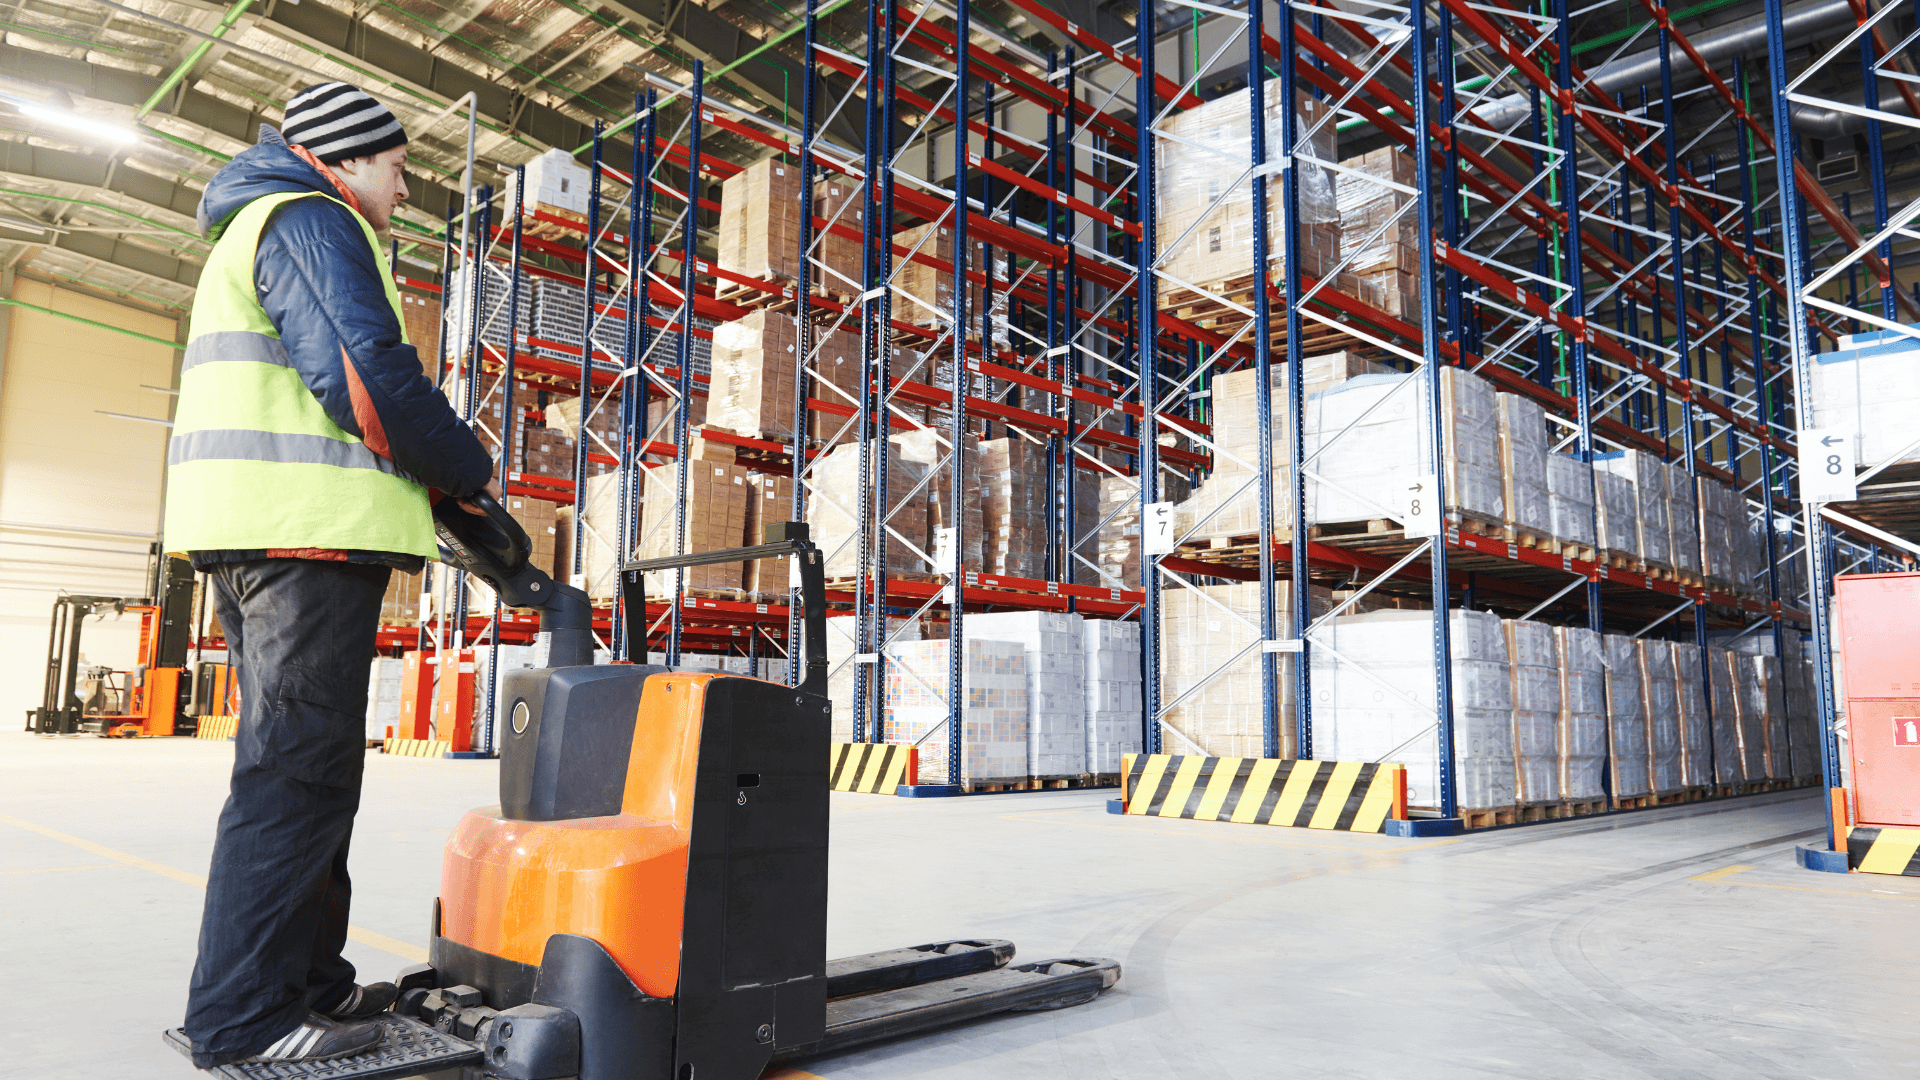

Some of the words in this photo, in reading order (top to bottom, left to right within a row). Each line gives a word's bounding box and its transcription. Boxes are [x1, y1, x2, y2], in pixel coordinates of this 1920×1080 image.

[1826, 454, 1842, 475] 8
[1411, 499, 1421, 516] 8
[1158, 521, 1167, 536] 7
[941, 545, 947, 557] 7
